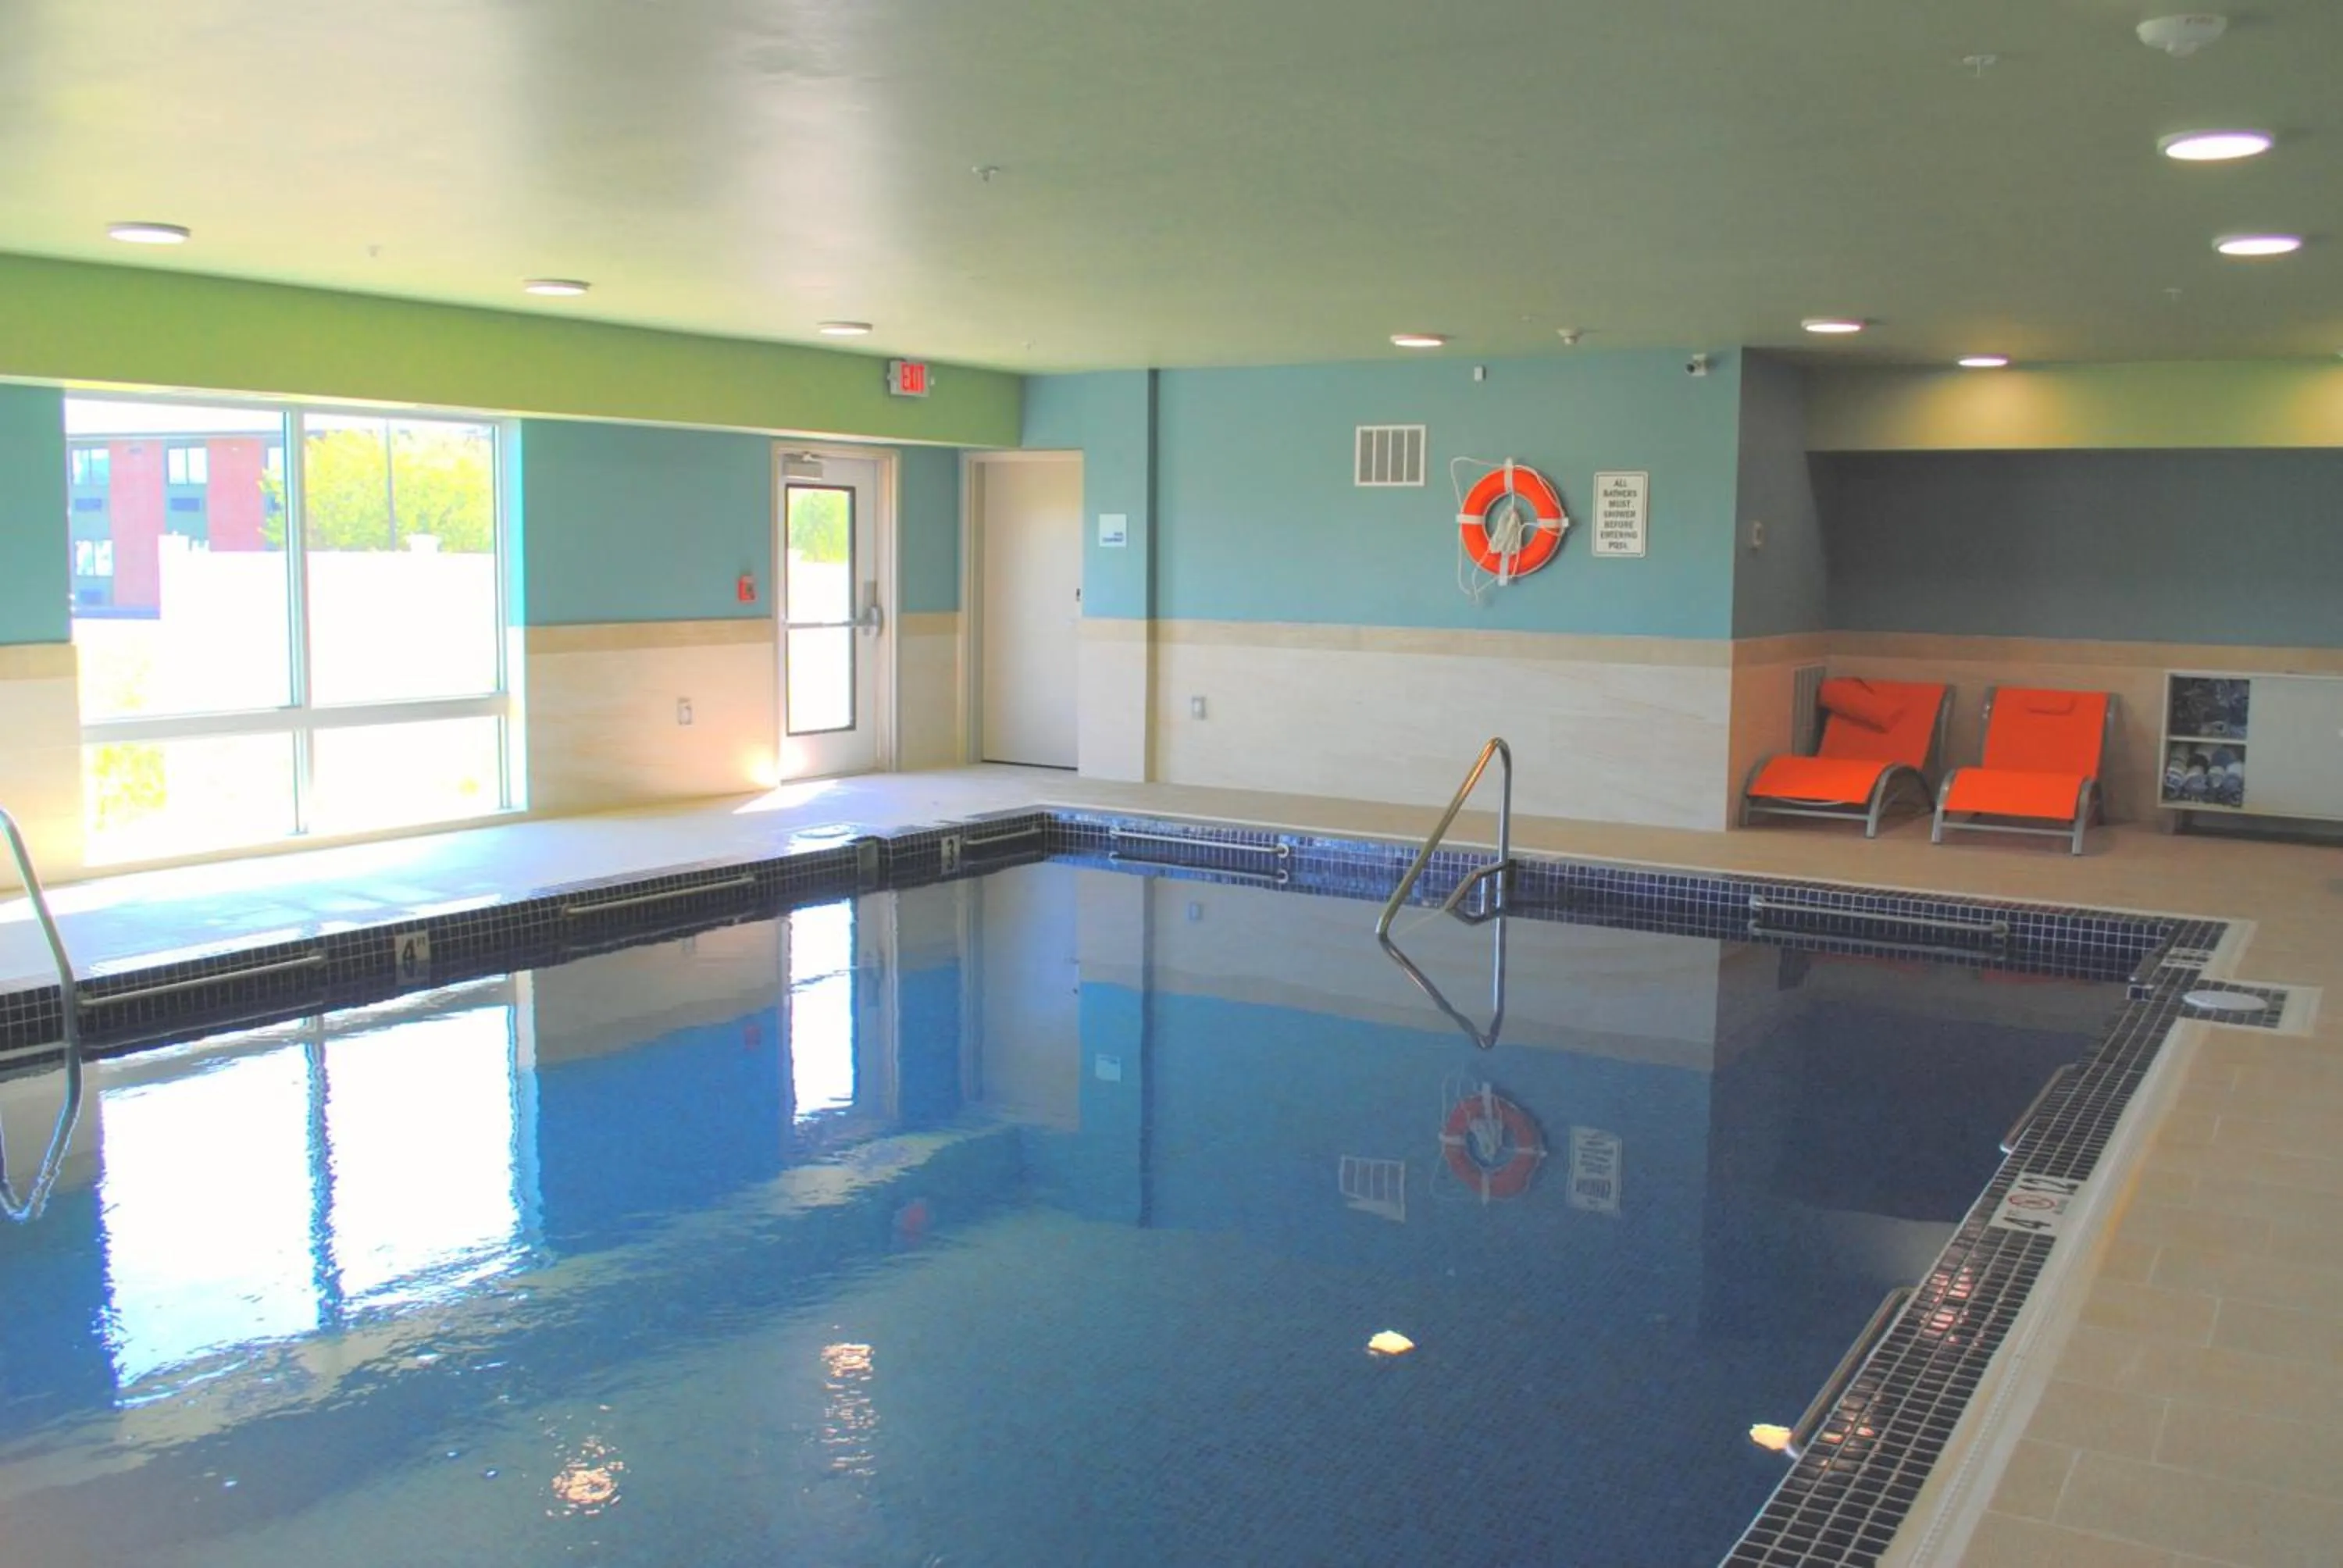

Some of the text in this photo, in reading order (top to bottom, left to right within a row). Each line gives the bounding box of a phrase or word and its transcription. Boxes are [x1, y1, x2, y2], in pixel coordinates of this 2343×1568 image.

[901, 363, 925, 393] EXIT
[1614, 479, 1627, 487] ALL
[1604, 520, 1634, 529] BEFORE
[1600, 531, 1638, 540] ENTERING
[403, 938, 417, 960] 4
